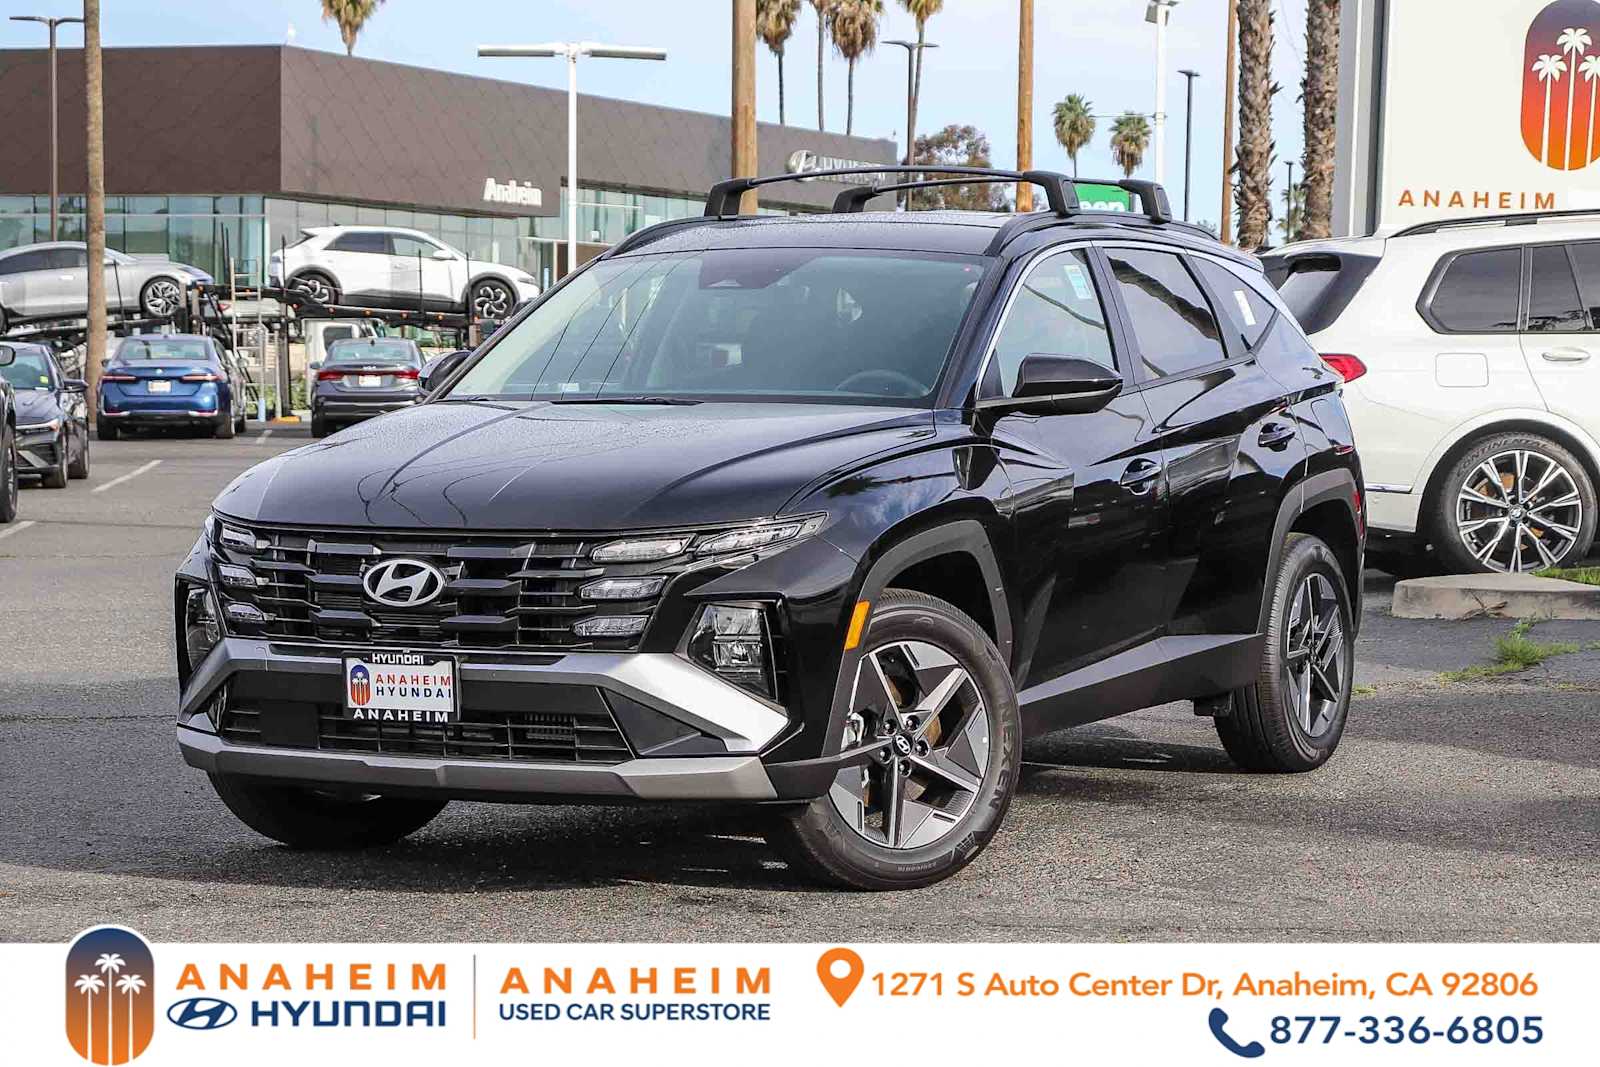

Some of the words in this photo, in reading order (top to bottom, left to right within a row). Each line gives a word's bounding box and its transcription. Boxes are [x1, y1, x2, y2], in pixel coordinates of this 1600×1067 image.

[483, 177, 543, 207] Anaheim
[1398, 189, 1556, 209] ANAHEIM
[372, 653, 424, 665] HYUNDAI
[375, 674, 451, 686] ANAHEIM
[376, 686, 451, 698] HYUNDAI
[353, 708, 449, 722] ANAHEIM
[987, 702, 1015, 812] NEXEN
